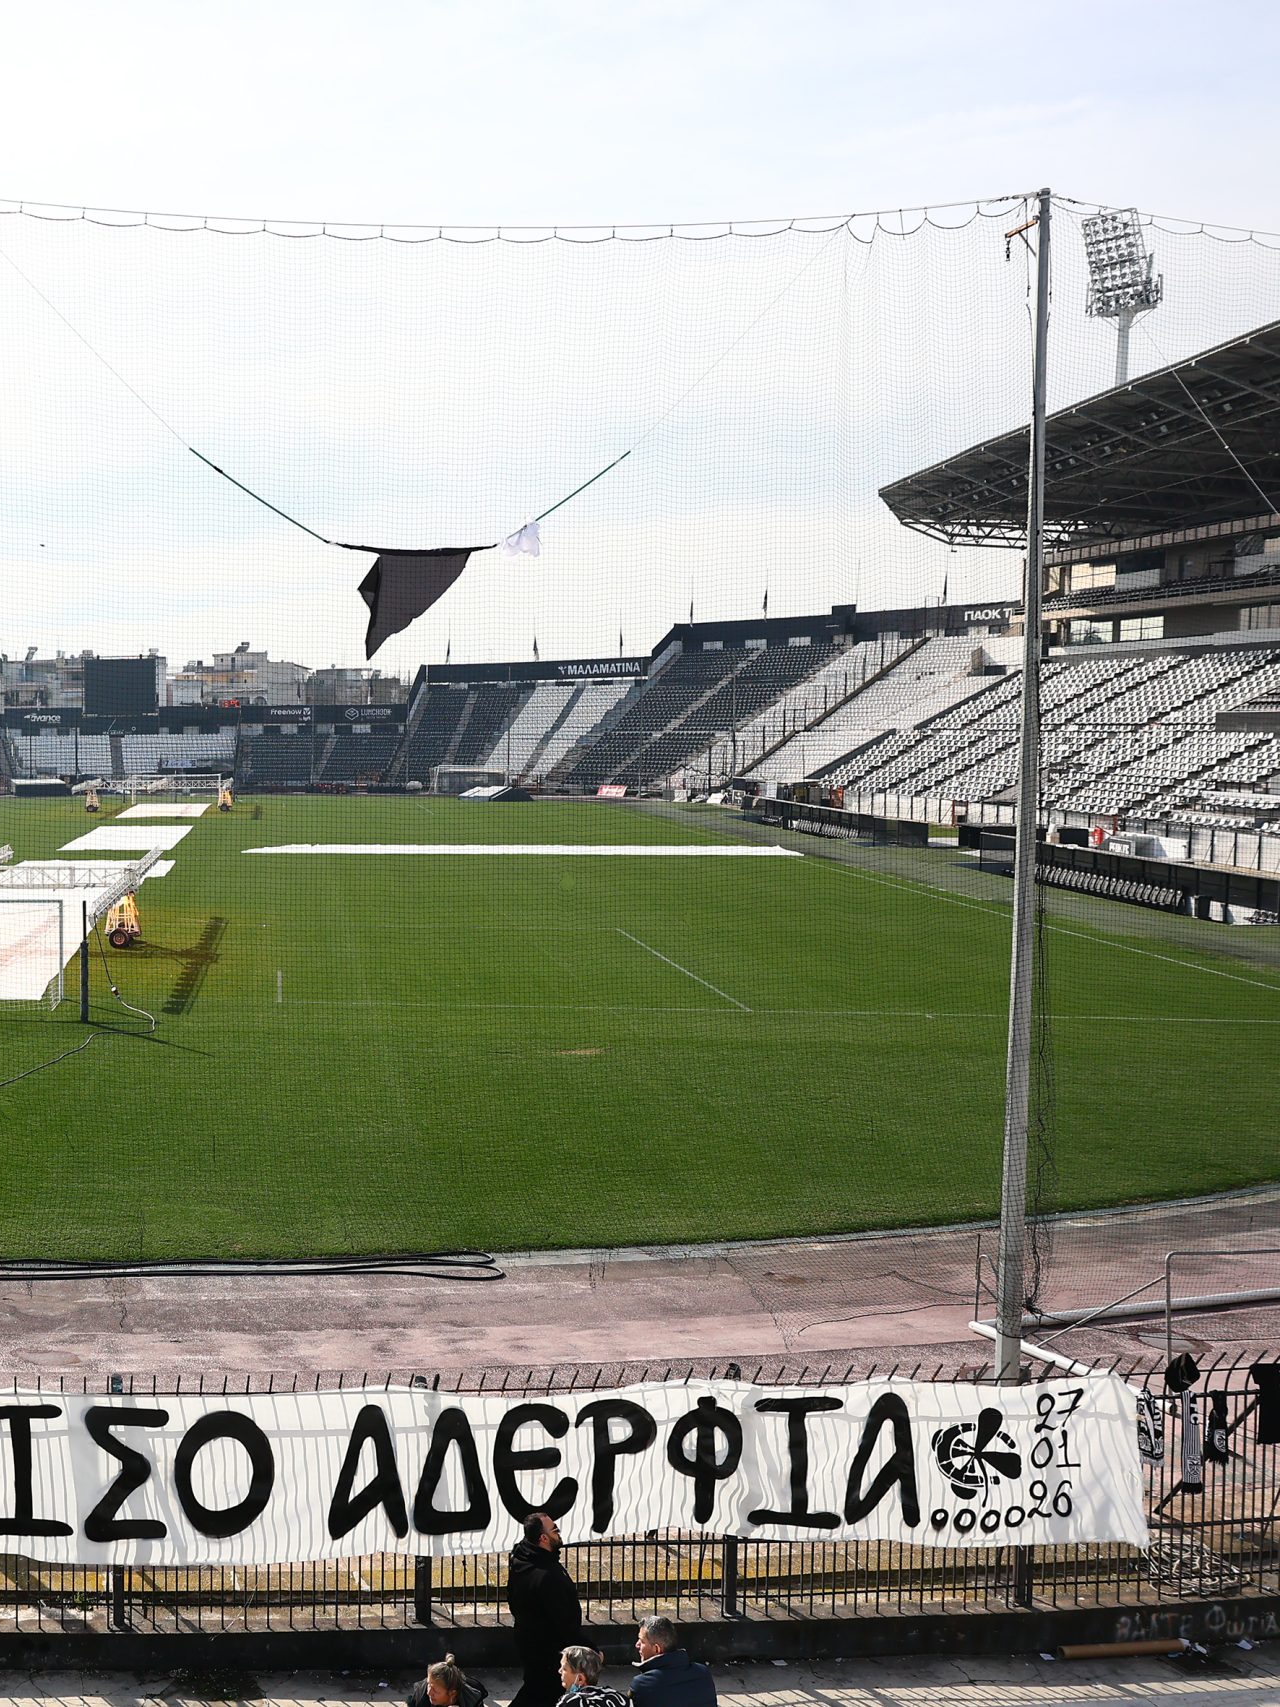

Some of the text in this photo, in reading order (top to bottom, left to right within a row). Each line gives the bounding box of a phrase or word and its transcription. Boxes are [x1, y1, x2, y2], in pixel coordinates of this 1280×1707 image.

[964, 609, 1002, 621] ΠΑΟΚ
[567, 662, 640, 675] ΜΑΛΑΜΑΤΙΝΑ
[1034, 1388, 1084, 1433] 27
[328, 1391, 920, 1541] ΑΔΕΡΦΙΑ
[1031, 1429, 1081, 1469] 01
[1027, 1480, 1073, 1518] 26
